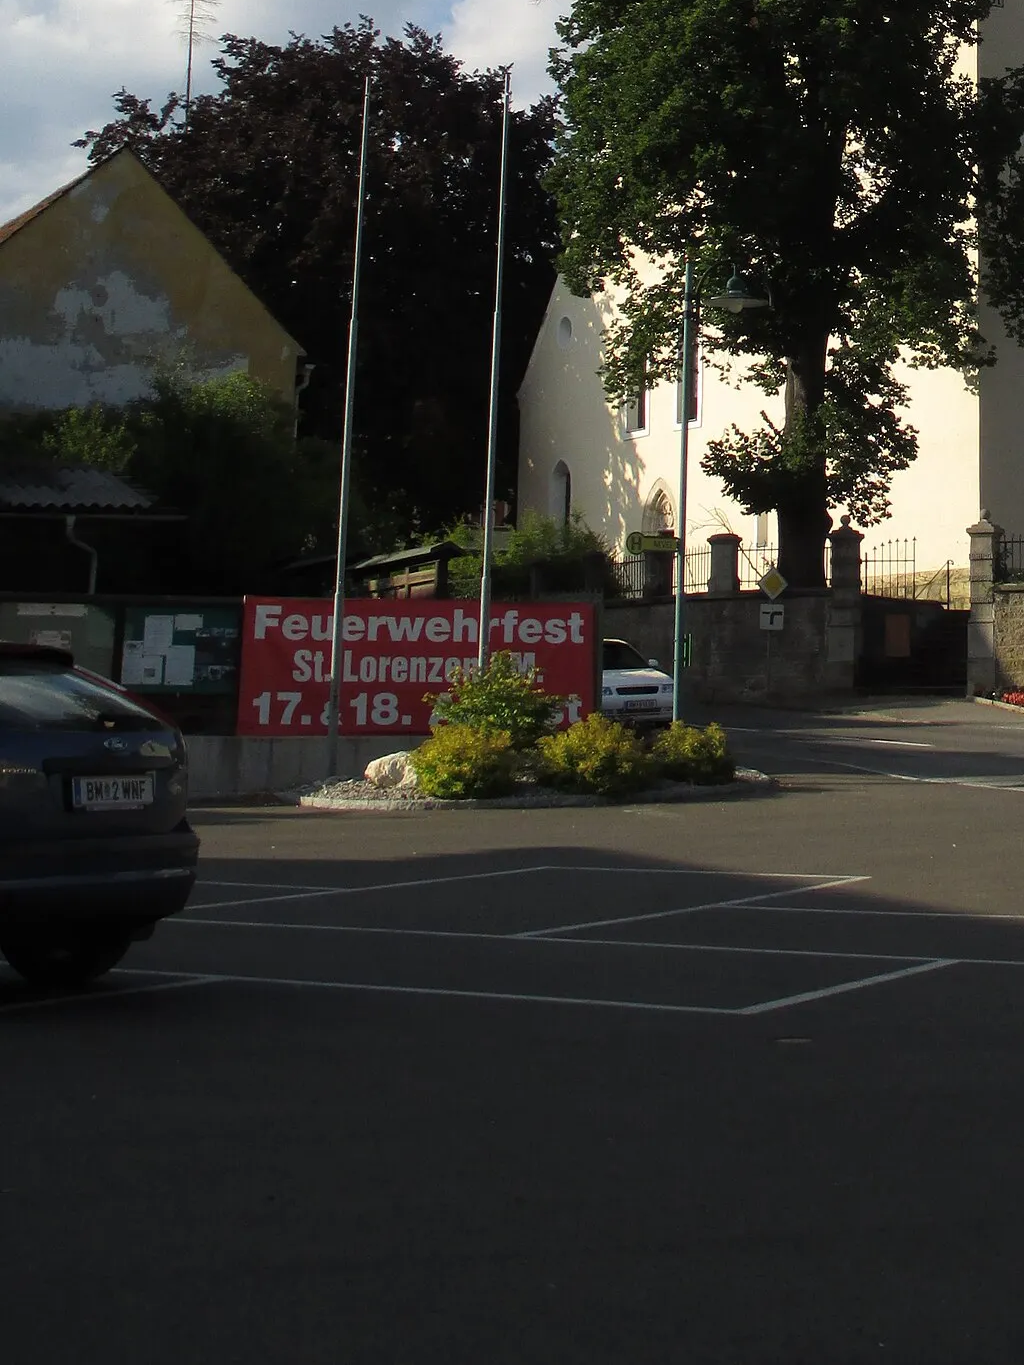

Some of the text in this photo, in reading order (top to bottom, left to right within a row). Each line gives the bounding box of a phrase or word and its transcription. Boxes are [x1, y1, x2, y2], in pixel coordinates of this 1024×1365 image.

[254, 605, 585, 644] Feuerwehrfest
[292, 649, 332, 683] St.
[252, 691, 312, 726] 17.
[350, 692, 412, 726] 18.
[86, 781, 104, 801] BM
[112, 781, 120, 800] 2
